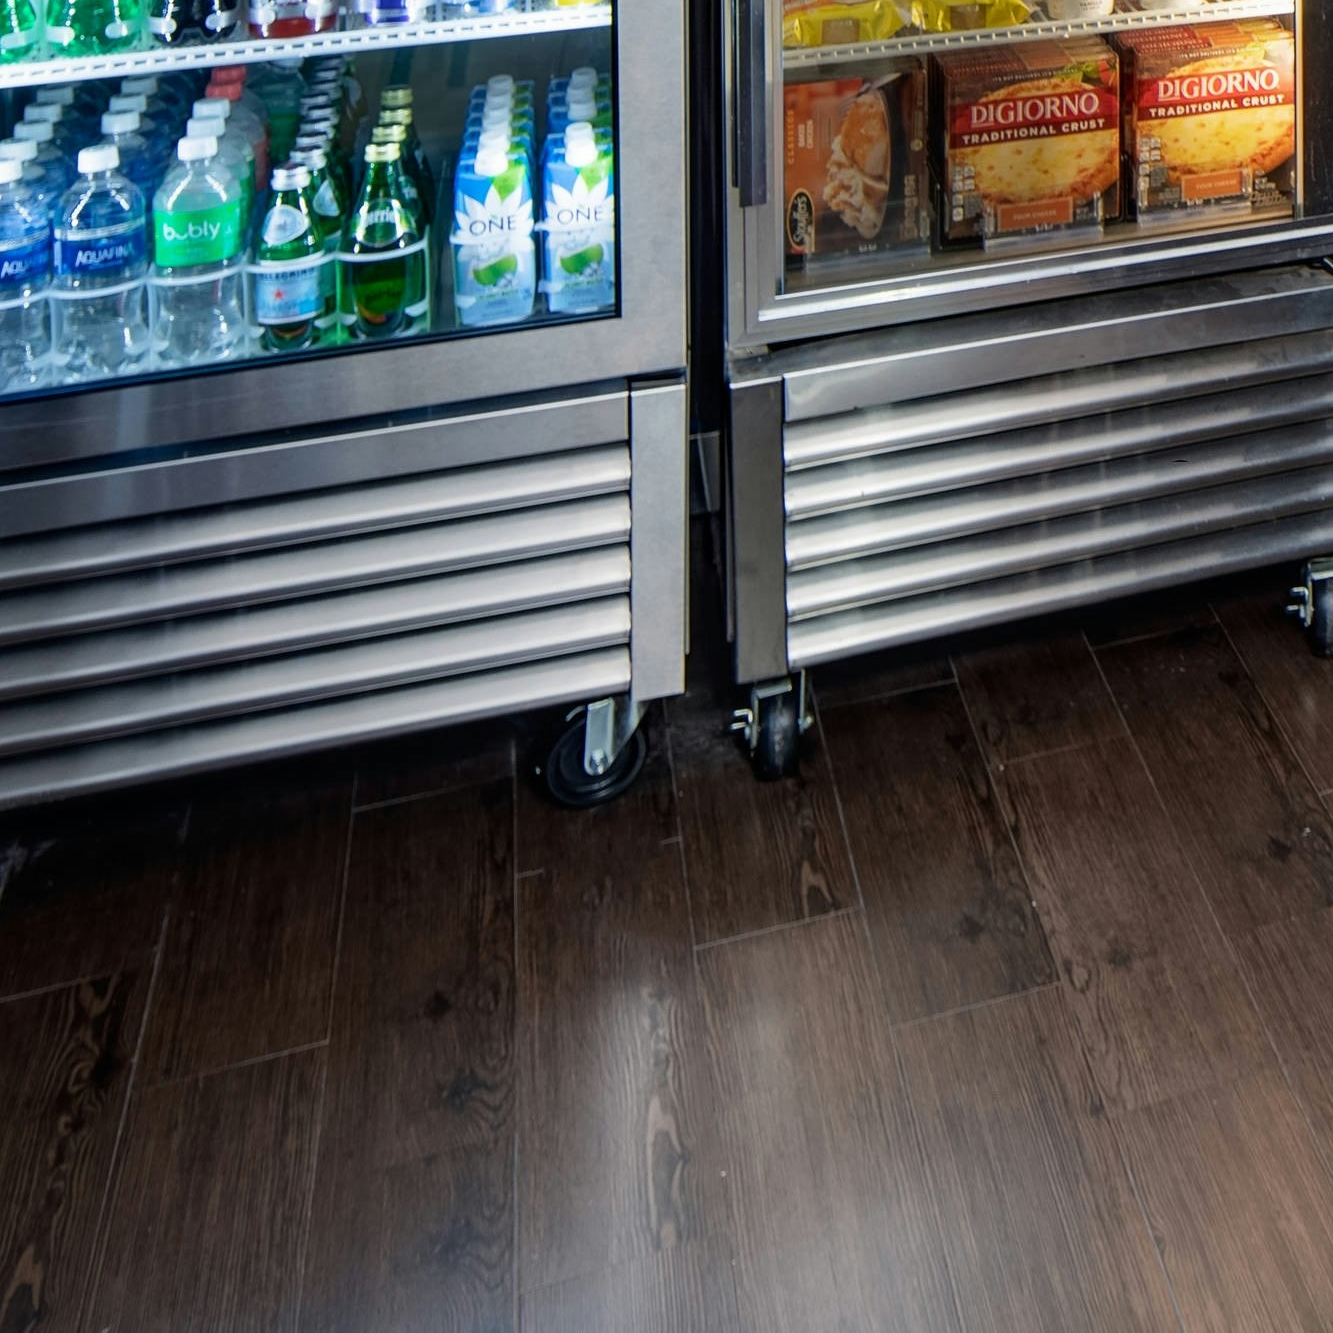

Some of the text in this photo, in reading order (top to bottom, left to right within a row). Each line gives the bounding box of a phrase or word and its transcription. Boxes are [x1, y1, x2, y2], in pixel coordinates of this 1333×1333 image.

[1149, 94, 1285, 118] TRADITIONAL CRUST
[962, 118, 1106, 146] TRADITIONAL CRUST
[469, 216, 517, 236] ONE
[556, 206, 604, 224] ONE
